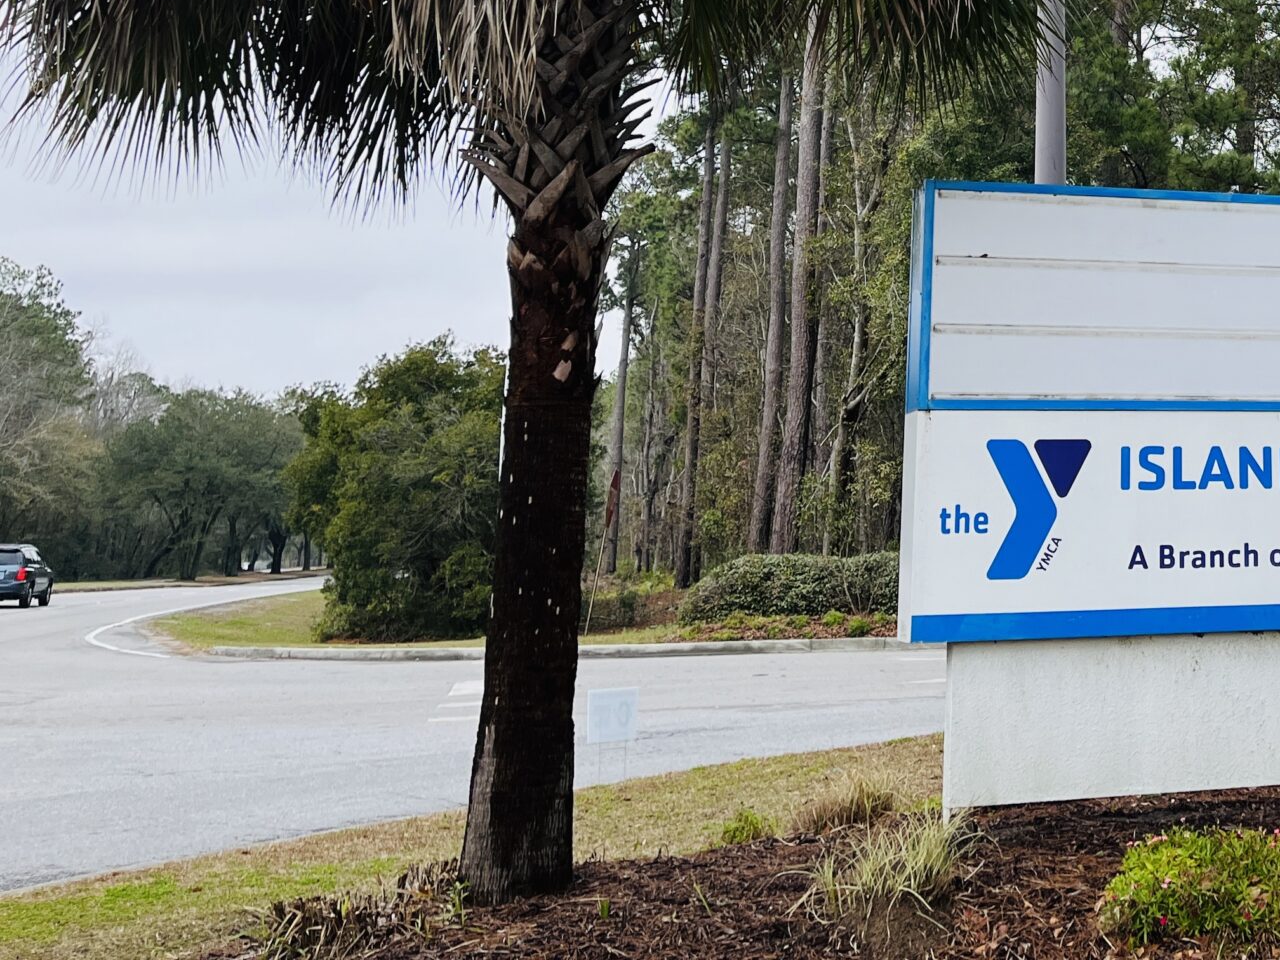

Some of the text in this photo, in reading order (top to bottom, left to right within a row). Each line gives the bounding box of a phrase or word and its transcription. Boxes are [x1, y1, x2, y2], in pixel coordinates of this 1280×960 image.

[939, 503, 989, 535] the
[1035, 537, 1063, 572] YMCA
[1127, 544, 1149, 570] A
[1159, 542, 1259, 569] Branch
